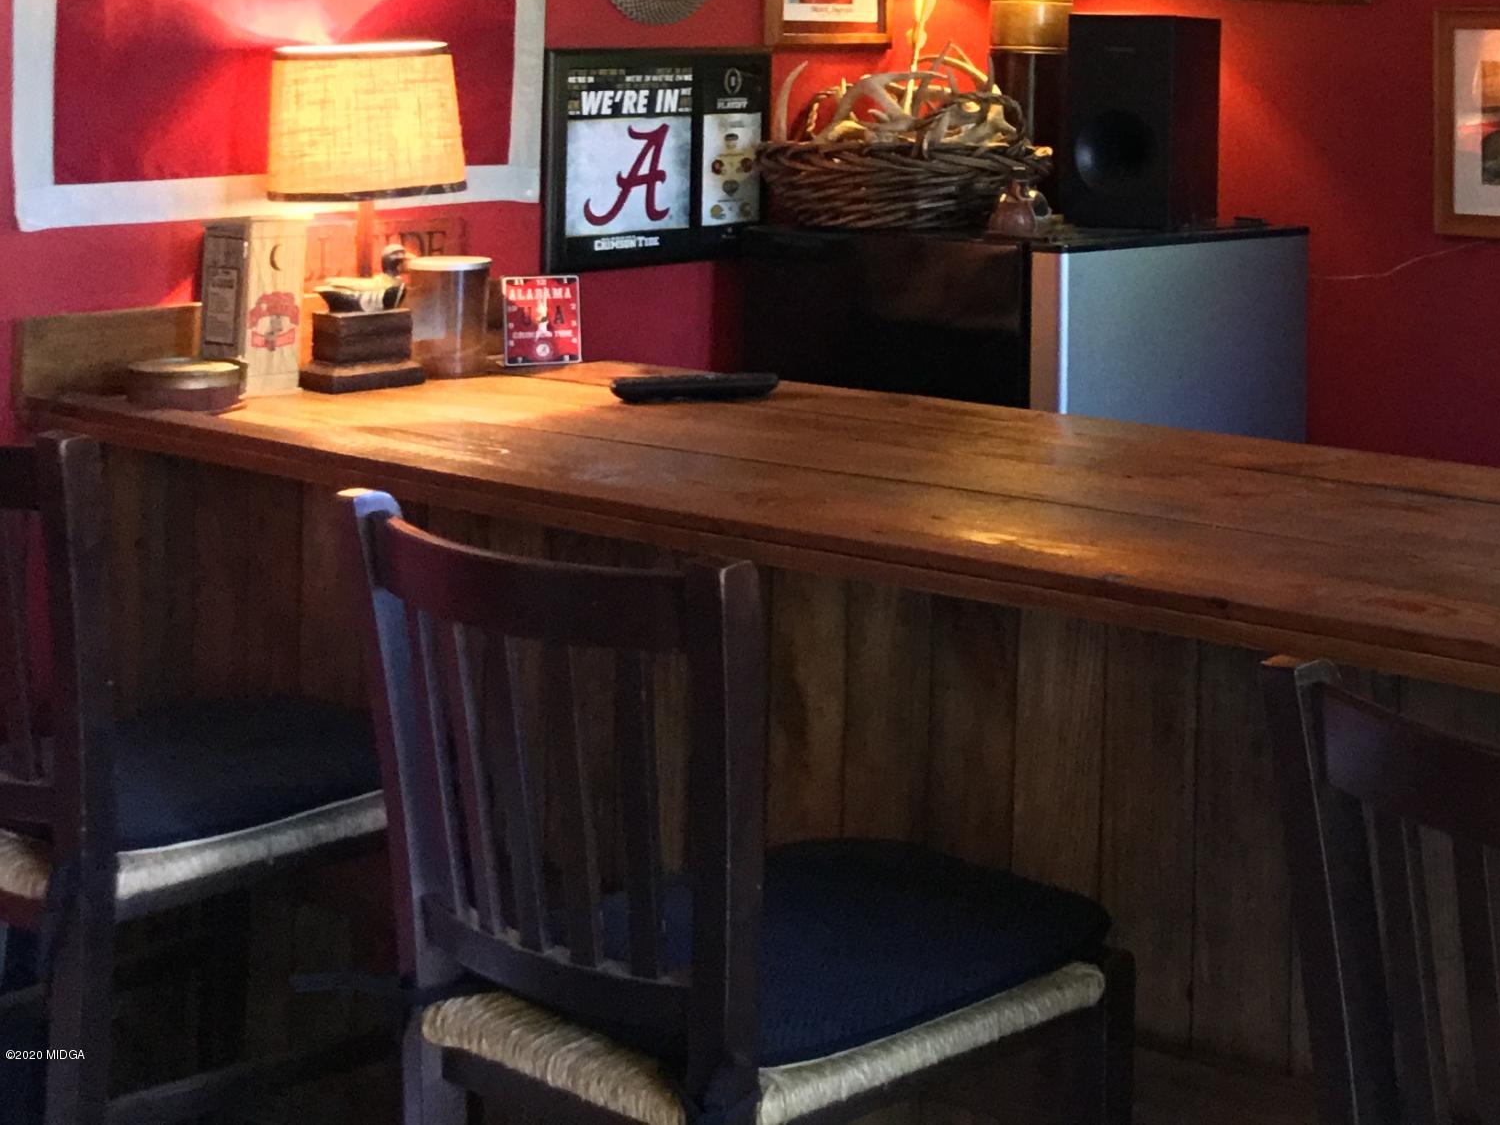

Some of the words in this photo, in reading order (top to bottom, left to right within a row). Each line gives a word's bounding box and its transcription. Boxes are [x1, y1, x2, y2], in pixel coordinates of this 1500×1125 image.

[581, 89, 650, 115] WE'RE
[655, 88, 680, 113] IN
[508, 286, 572, 301] ALABAMA
